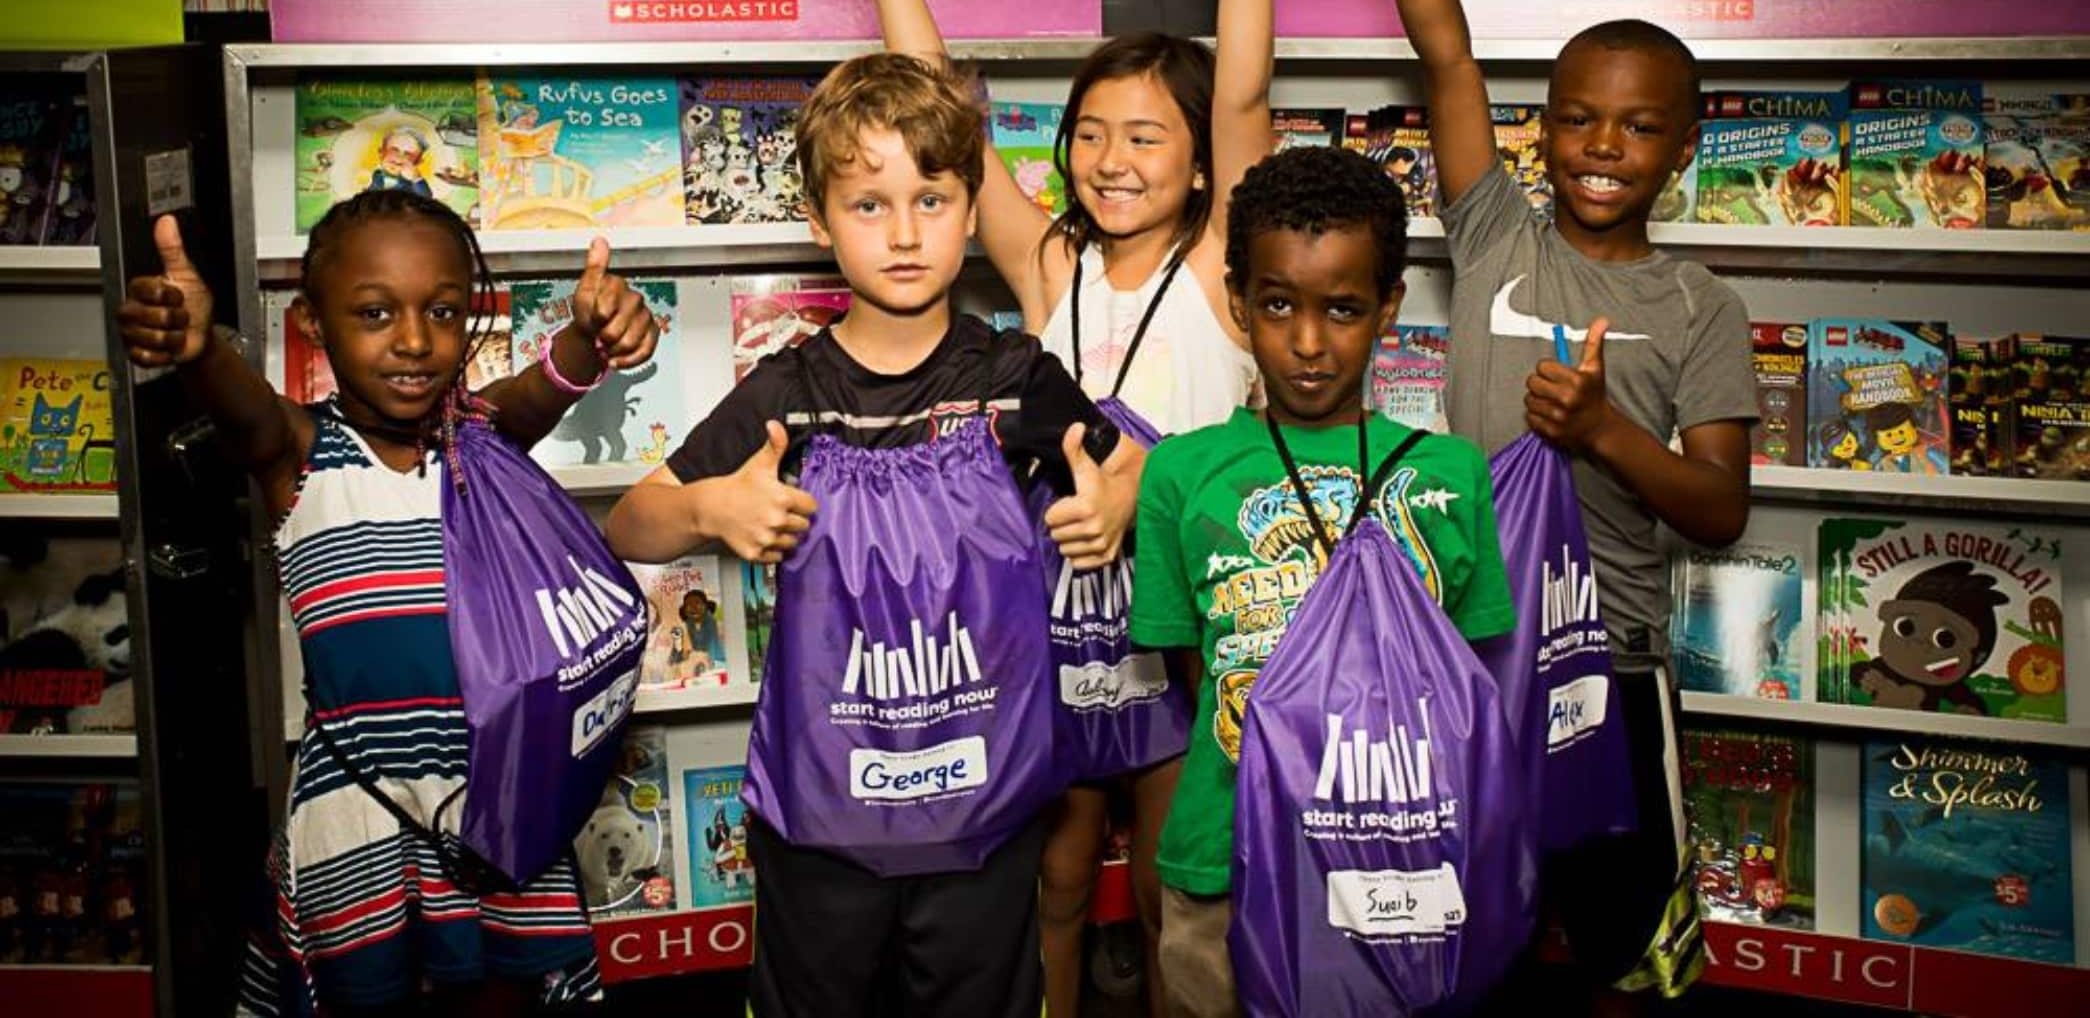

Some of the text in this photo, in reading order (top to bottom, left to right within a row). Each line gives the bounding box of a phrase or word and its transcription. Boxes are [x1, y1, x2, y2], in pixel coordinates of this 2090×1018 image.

[637, 1, 794, 18] SCHOLASTIC
[539, 82, 667, 105] Rufus Goes
[1887, 85, 1974, 107] CHIMA
[565, 107, 643, 127] to Sea
[1749, 96, 1831, 117] CHIMA
[1718, 123, 1790, 143] ORIGINS
[1855, 114, 1930, 135] ORIGINS
[1718, 148, 1785, 163] HANDBOOK
[1856, 140, 1925, 156] HANDBOOK
[19, 366, 73, 391] Pete
[2021, 404, 2074, 419] NINJA
[1752, 555, 1783, 572] Tale
[1783, 555, 1797, 575] 2
[1856, 531, 2052, 595] STILL A GORILLA!
[1209, 561, 1308, 618] NEED
[1237, 603, 1285, 634] FOR
[1051, 622, 1080, 639] tart
[558, 655, 594, 682] start
[831, 687, 996, 719] start reading now
[1551, 701, 1584, 729] Alex
[1891, 744, 2028, 777] Shimmer
[861, 757, 968, 791] George
[1889, 771, 2044, 819] & Splash
[1303, 809, 1354, 828] start
[1360, 810, 1437, 831] reading
